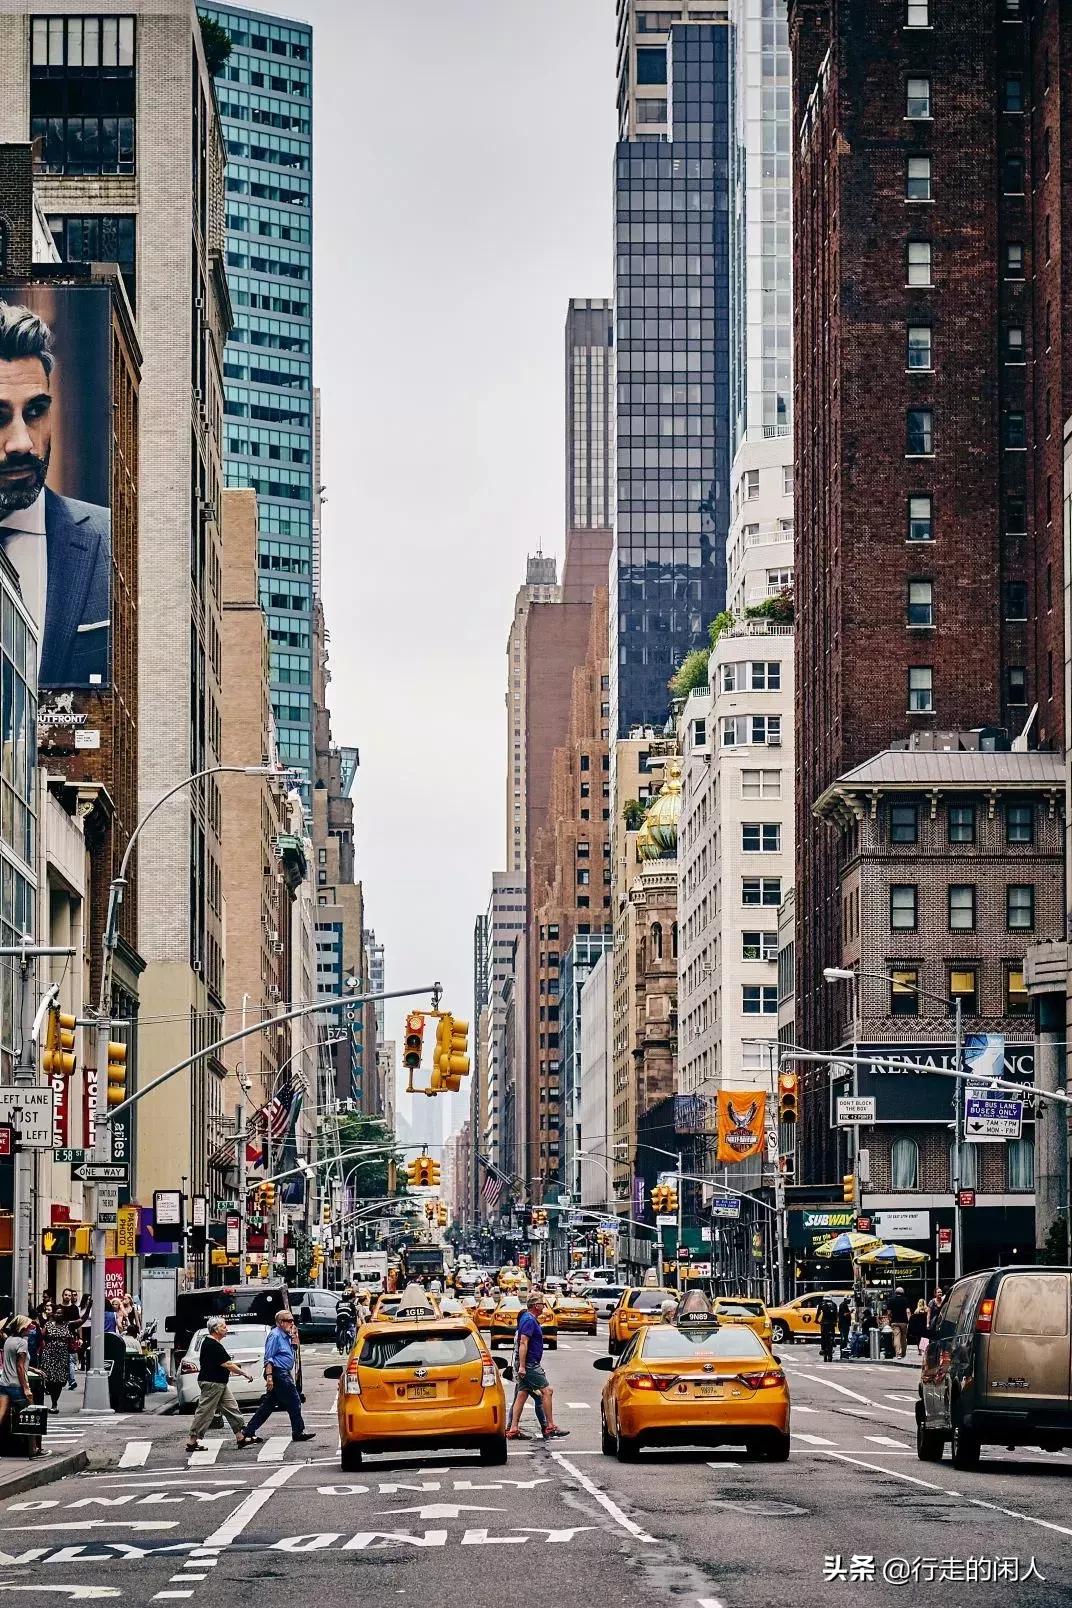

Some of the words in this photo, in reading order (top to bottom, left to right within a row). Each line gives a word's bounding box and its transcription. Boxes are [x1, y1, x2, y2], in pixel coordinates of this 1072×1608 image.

[868, 1055, 1034, 1075] RENAISNC
[25, 1095, 49, 1105] LANE
[87, 1071, 97, 1149] MODELL
[26, 1130, 48, 1140] LEFT
[55, 1150, 60, 1161] E
[62, 1150, 73, 1161] 58
[79, 1168, 96, 1176] ONE
[103, 1168, 122, 1176] WAY
[804, 1214, 854, 1227] SUBWAY
[119, 1218, 127, 1246] PHOTO
[126, 1212, 135, 1252] PASSPORT
[105, 1273, 123, 1281] 00%
[104, 1281, 124, 1289] EMY
[406, 1308, 425, 1316] 1G15
[317, 1478, 552, 1496] ONLY
[6, 1489, 245, 1511] ONLY
[267, 1526, 600, 1552] ONLY
[0, 1542, 205, 1566] NLY
